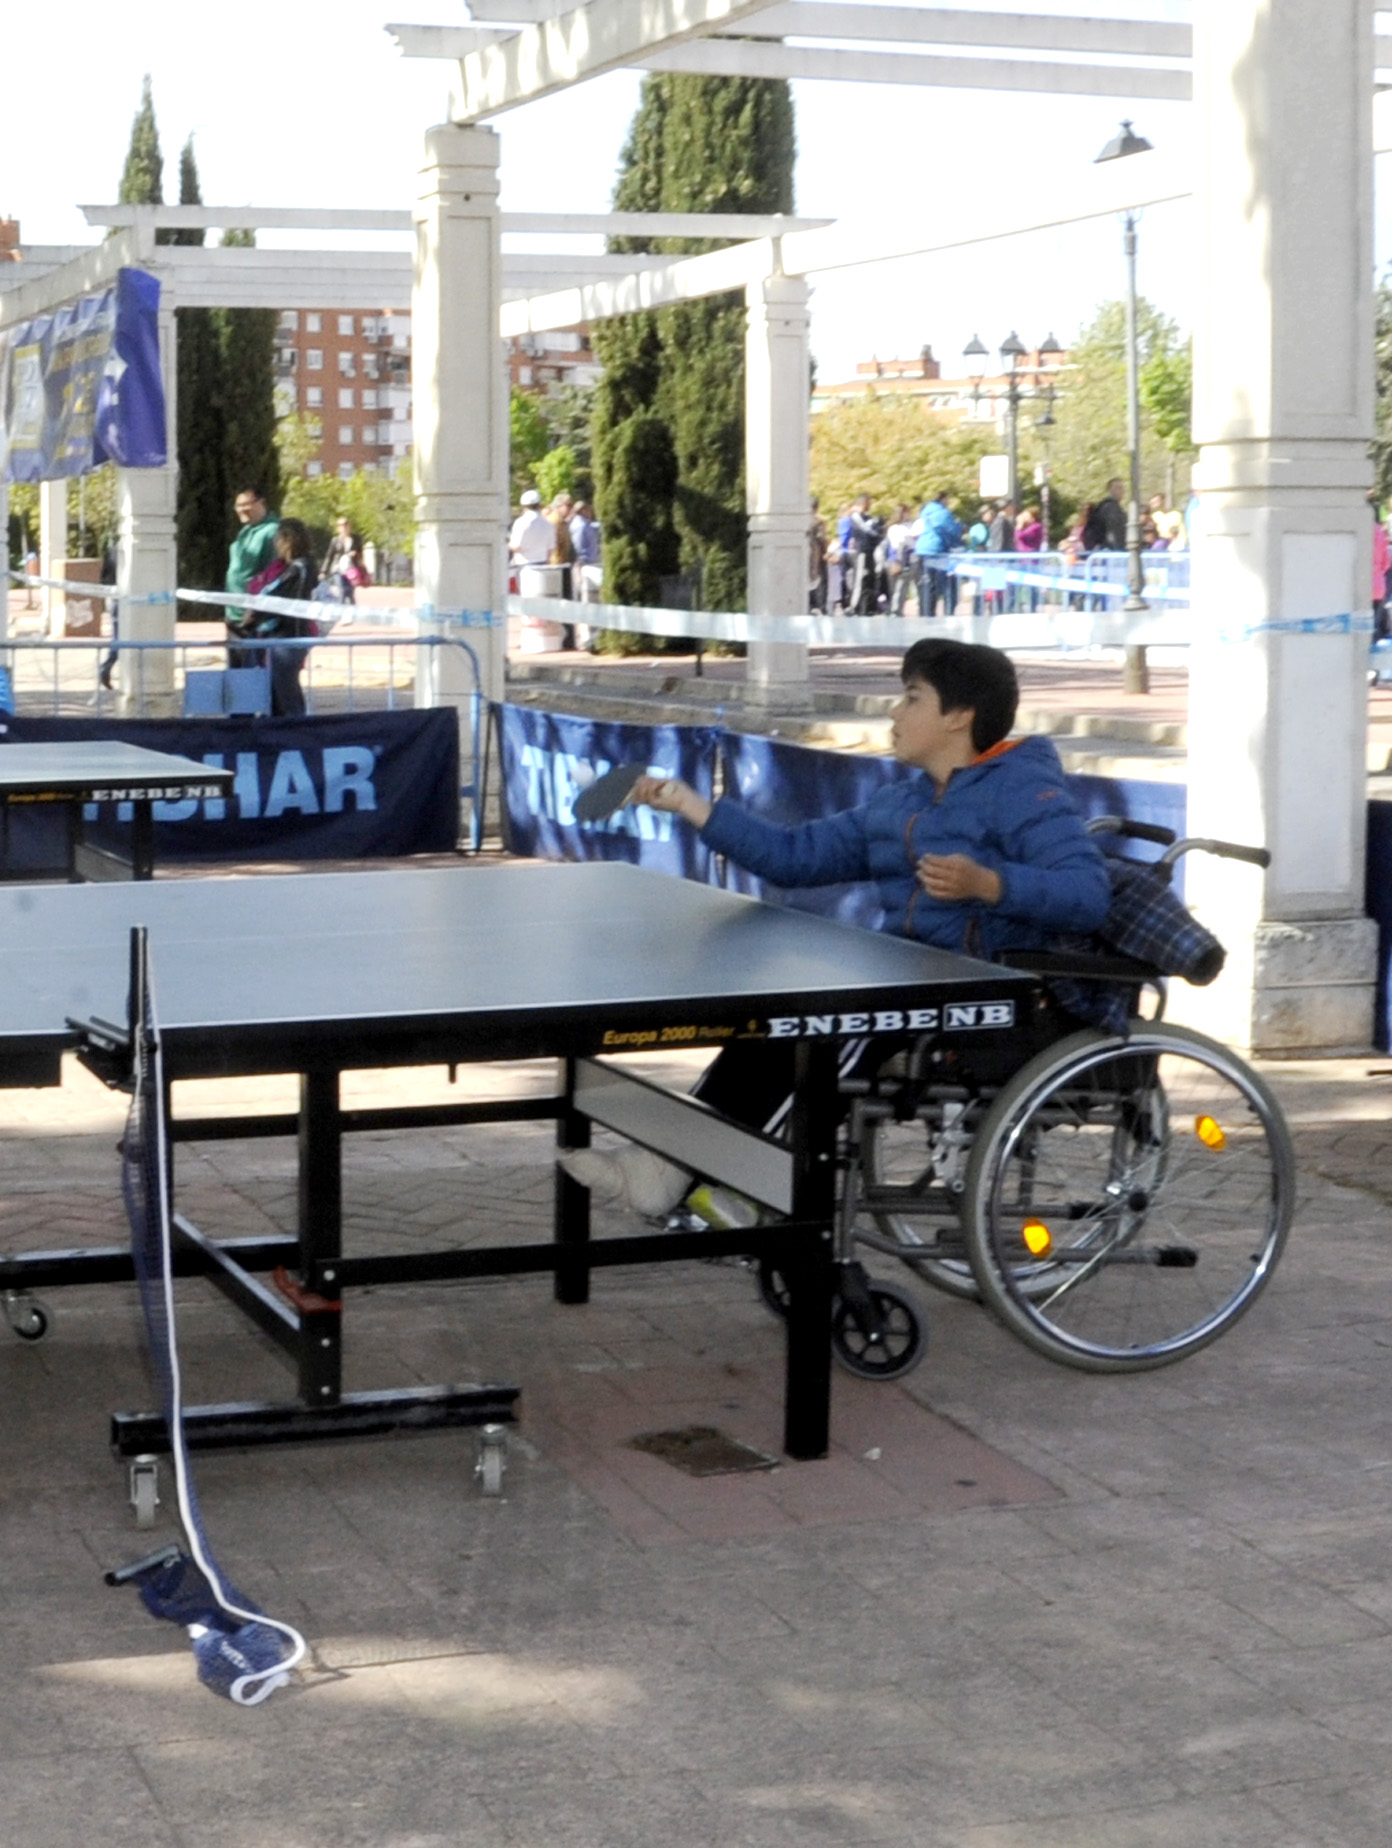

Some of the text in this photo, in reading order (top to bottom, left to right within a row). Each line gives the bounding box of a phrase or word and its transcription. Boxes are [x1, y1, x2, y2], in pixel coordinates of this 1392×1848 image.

[91, 785, 223, 801] ENEBE NB
[603, 1030, 658, 1046] Europa
[660, 1025, 697, 1042] 2000
[768, 1008, 939, 1038] ENEBE
[948, 1004, 1010, 1027] NB
